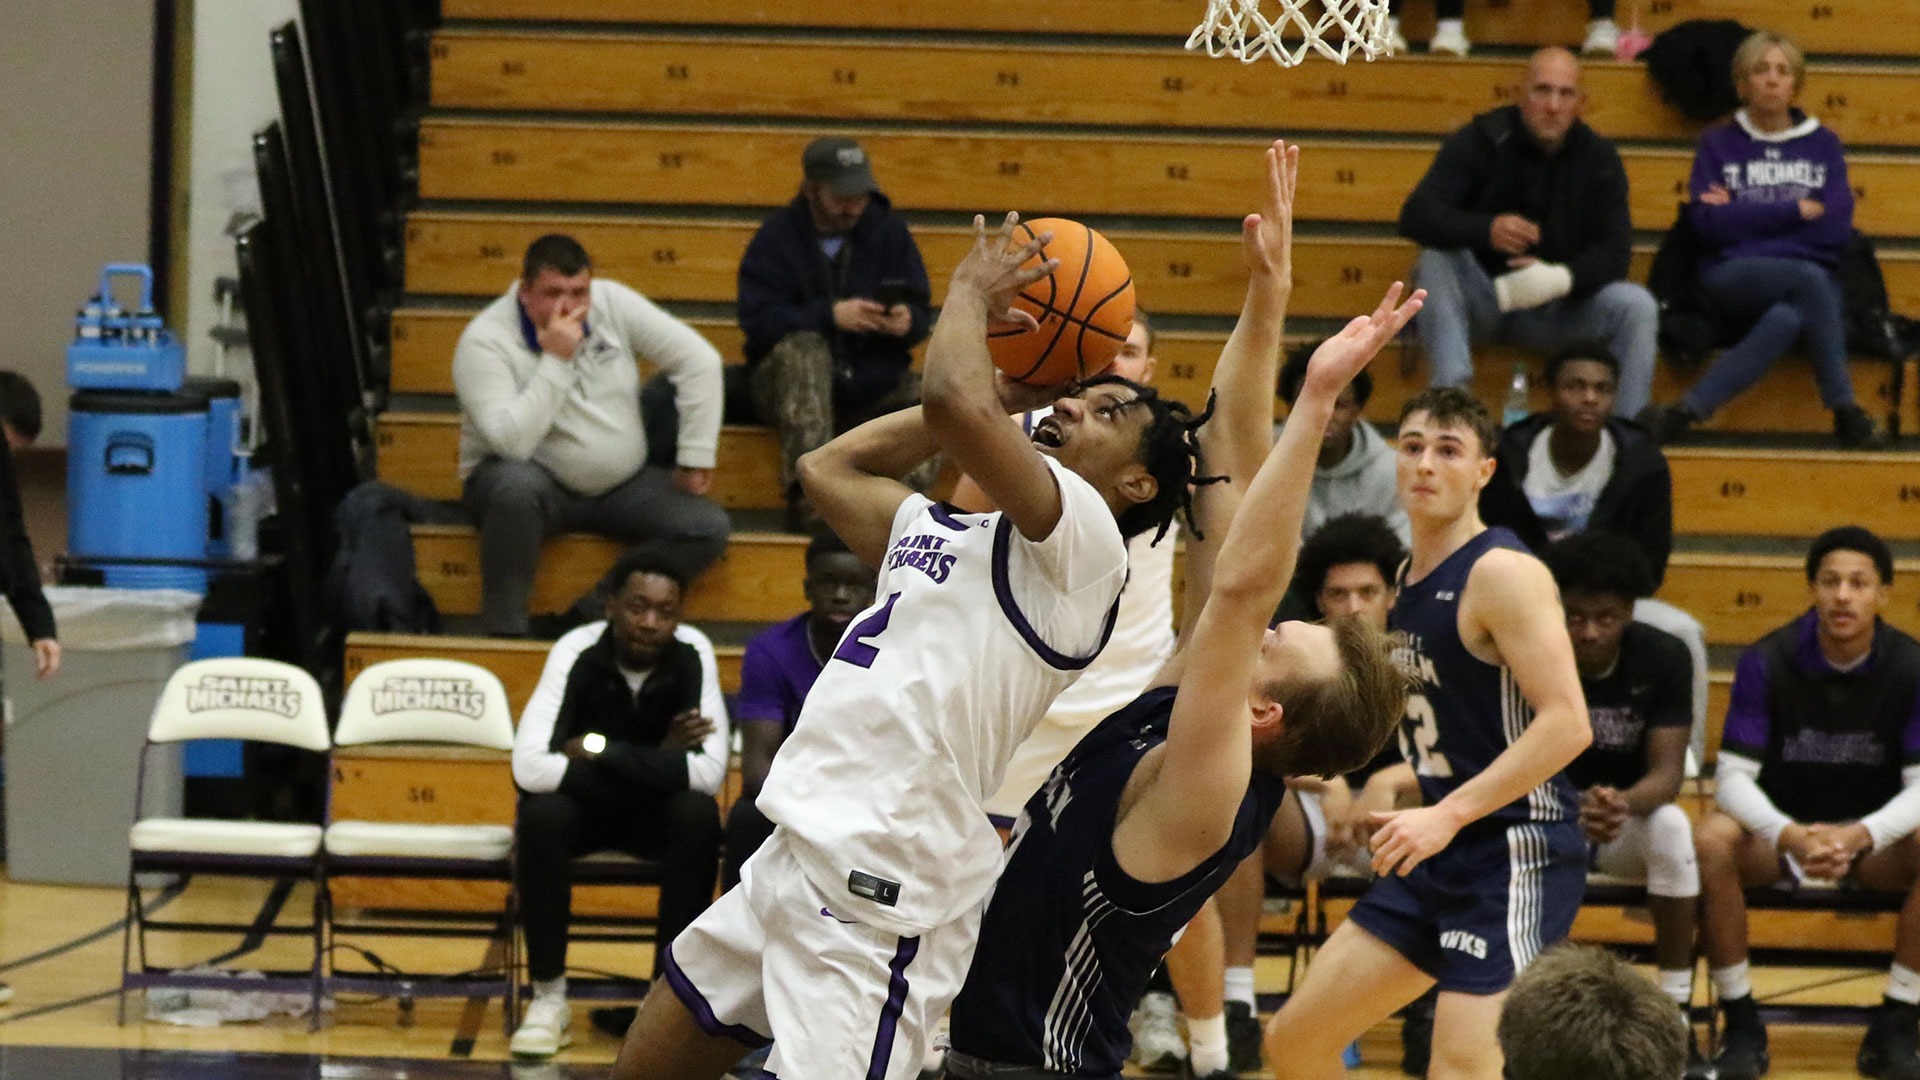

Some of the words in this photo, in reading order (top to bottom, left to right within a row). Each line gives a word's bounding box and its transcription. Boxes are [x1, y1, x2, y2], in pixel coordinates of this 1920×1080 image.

[1746, 159, 1825, 189] MICHAELS
[891, 534, 950, 552] AINT
[833, 591, 902, 669] 2
[199, 675, 289, 694] SAINT
[383, 677, 472, 694] SAINT
[184, 685, 302, 719] MICHAELS
[369, 688, 485, 720] MICHAELS
[883, 887, 889, 897] L
